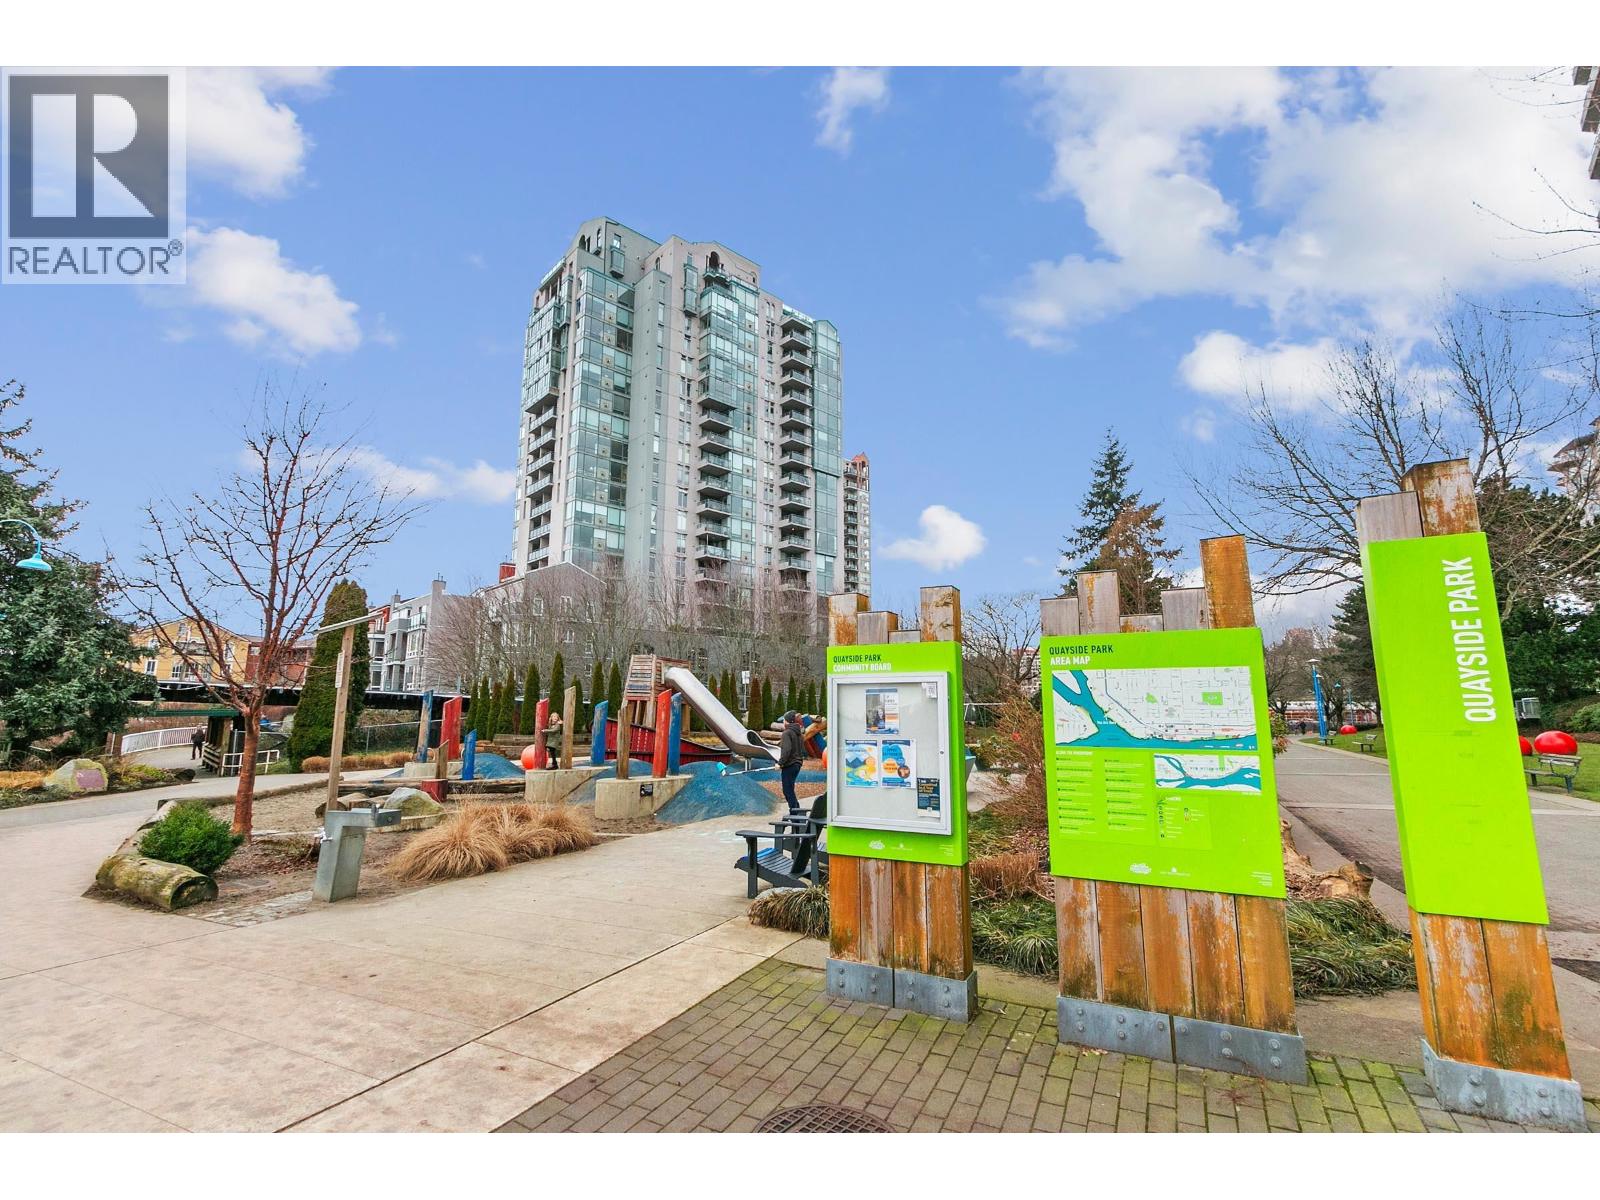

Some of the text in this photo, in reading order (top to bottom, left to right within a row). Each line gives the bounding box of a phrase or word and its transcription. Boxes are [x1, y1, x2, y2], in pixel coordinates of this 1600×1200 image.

[1441, 556, 1496, 723] QUAYSIDE PARK
[1049, 644, 1113, 655] QUAYSIDE PARK
[833, 653, 882, 663] QUAYSIDE PARK
[1050, 655, 1090, 666] AREA MAP
[833, 662, 892, 673] COMMUNITY BOARD
